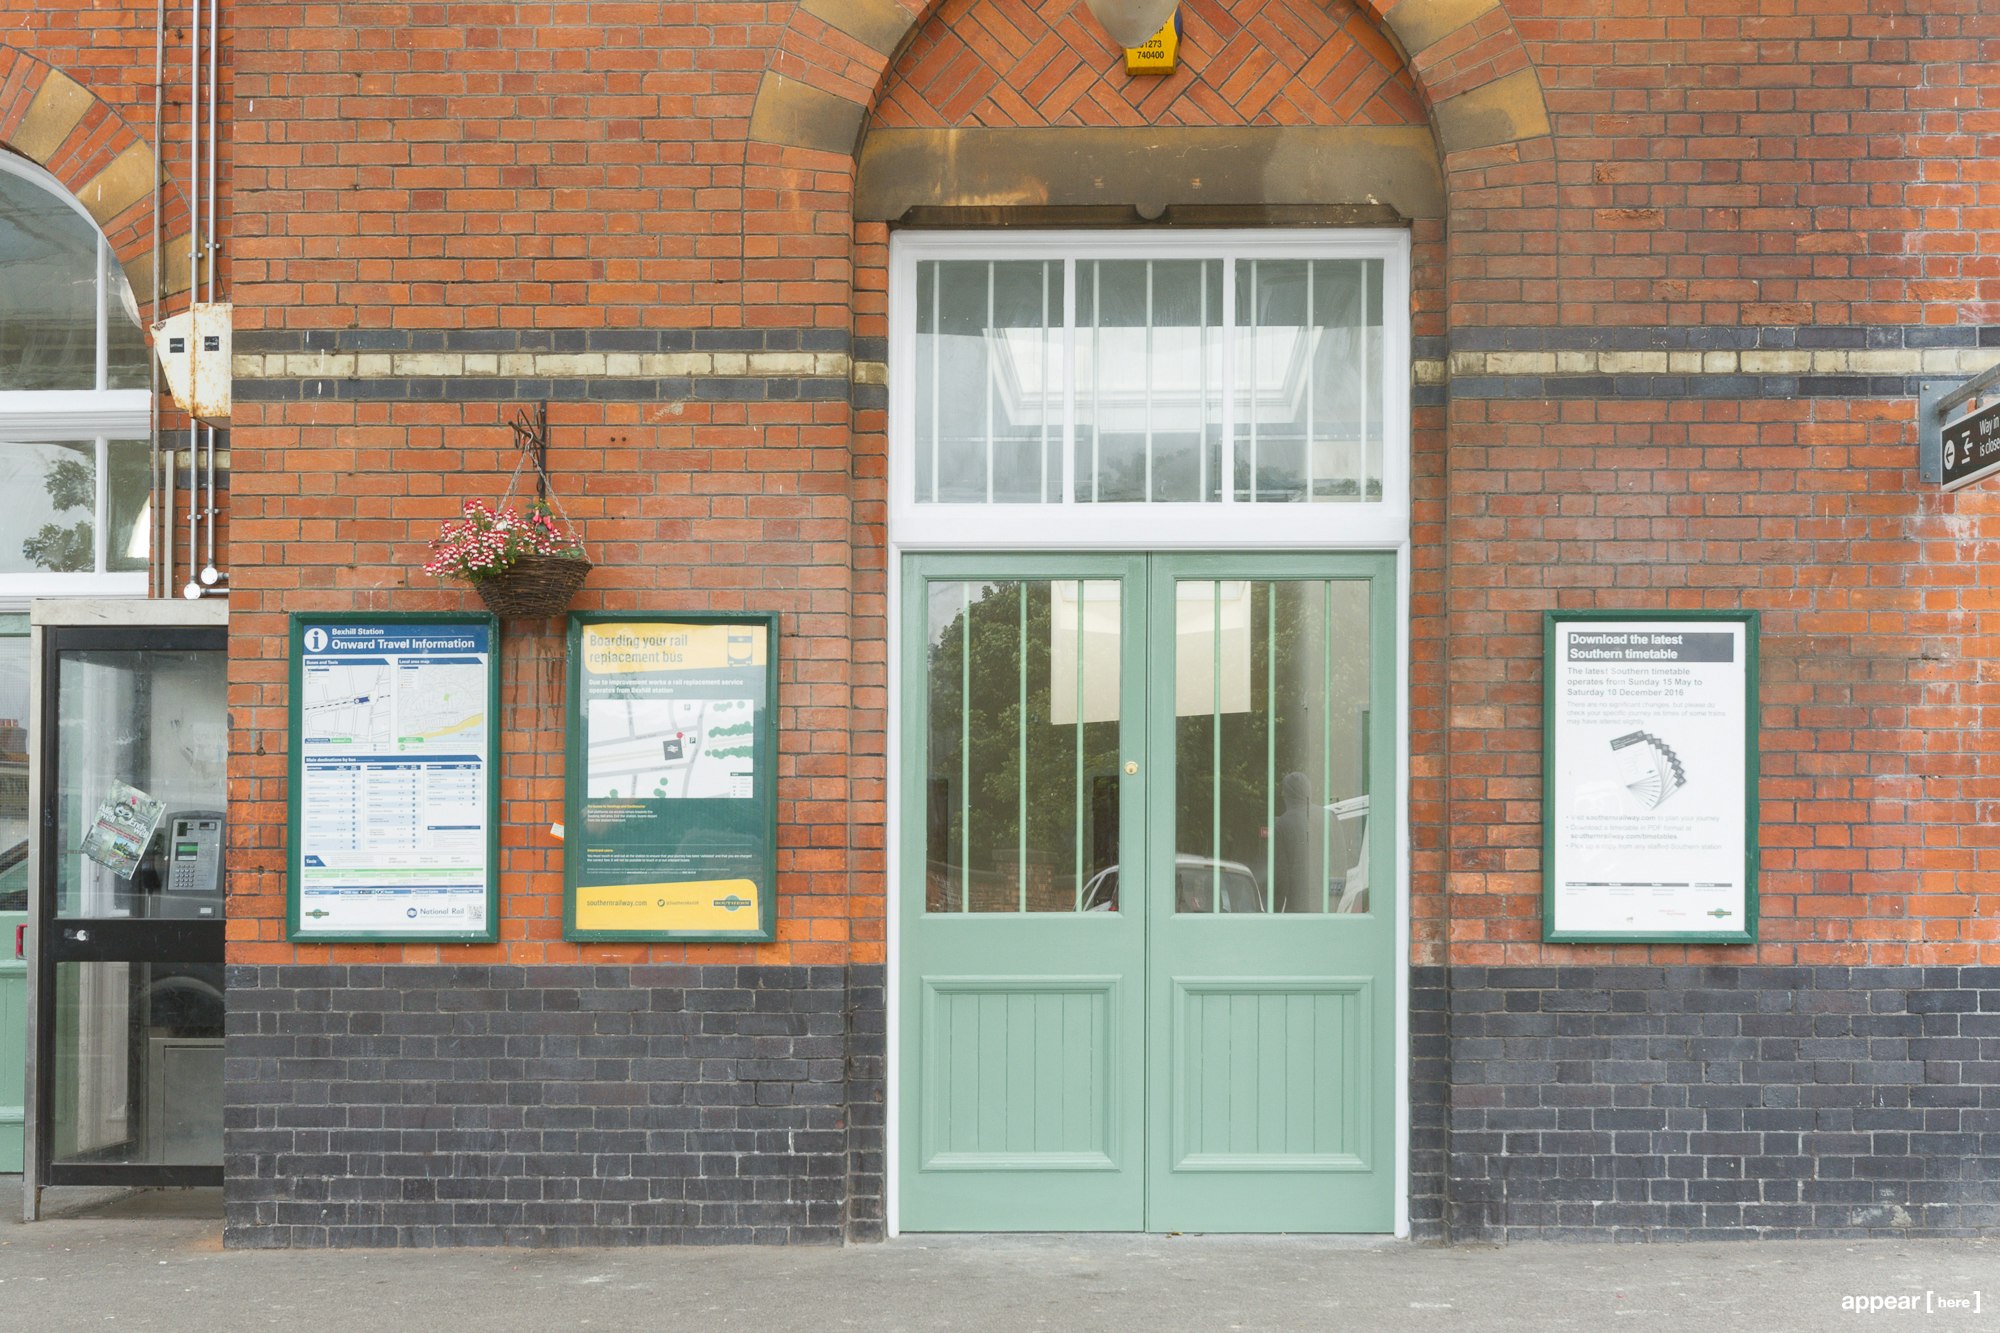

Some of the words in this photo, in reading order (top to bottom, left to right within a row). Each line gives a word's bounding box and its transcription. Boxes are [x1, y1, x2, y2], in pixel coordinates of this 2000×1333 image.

[1137, 51, 1164, 59] 740400
[1979, 419, 1993, 436] Way
[1993, 414, 1999, 430] in
[1979, 442, 1985, 457] is
[332, 628, 356, 636] Bexhill
[358, 628, 384, 636] Station
[332, 638, 376, 650] Onward
[378, 638, 409, 650] Travel
[412, 638, 475, 650] Information
[589, 635, 640, 648] Boarding
[642, 637, 667, 650] your
[669, 635, 688, 646] rail
[1570, 633, 1627, 645] Download
[1630, 633, 1648, 645] the
[1651, 633, 1683, 645] latest
[589, 651, 659, 665] replacement
[662, 651, 683, 663] bus
[1570, 649, 1622, 659] Southern
[1625, 649, 1678, 659] timetable
[609, 679, 647, 687] improvement
[683, 679, 720, 687] replacement
[1568, 679, 1604, 687] operates
[1628, 679, 1659, 688] Sunday
[1674, 679, 1691, 687] May
[1568, 689, 1604, 698] Saturday
[587, 899, 647, 908] southernrailway.com
